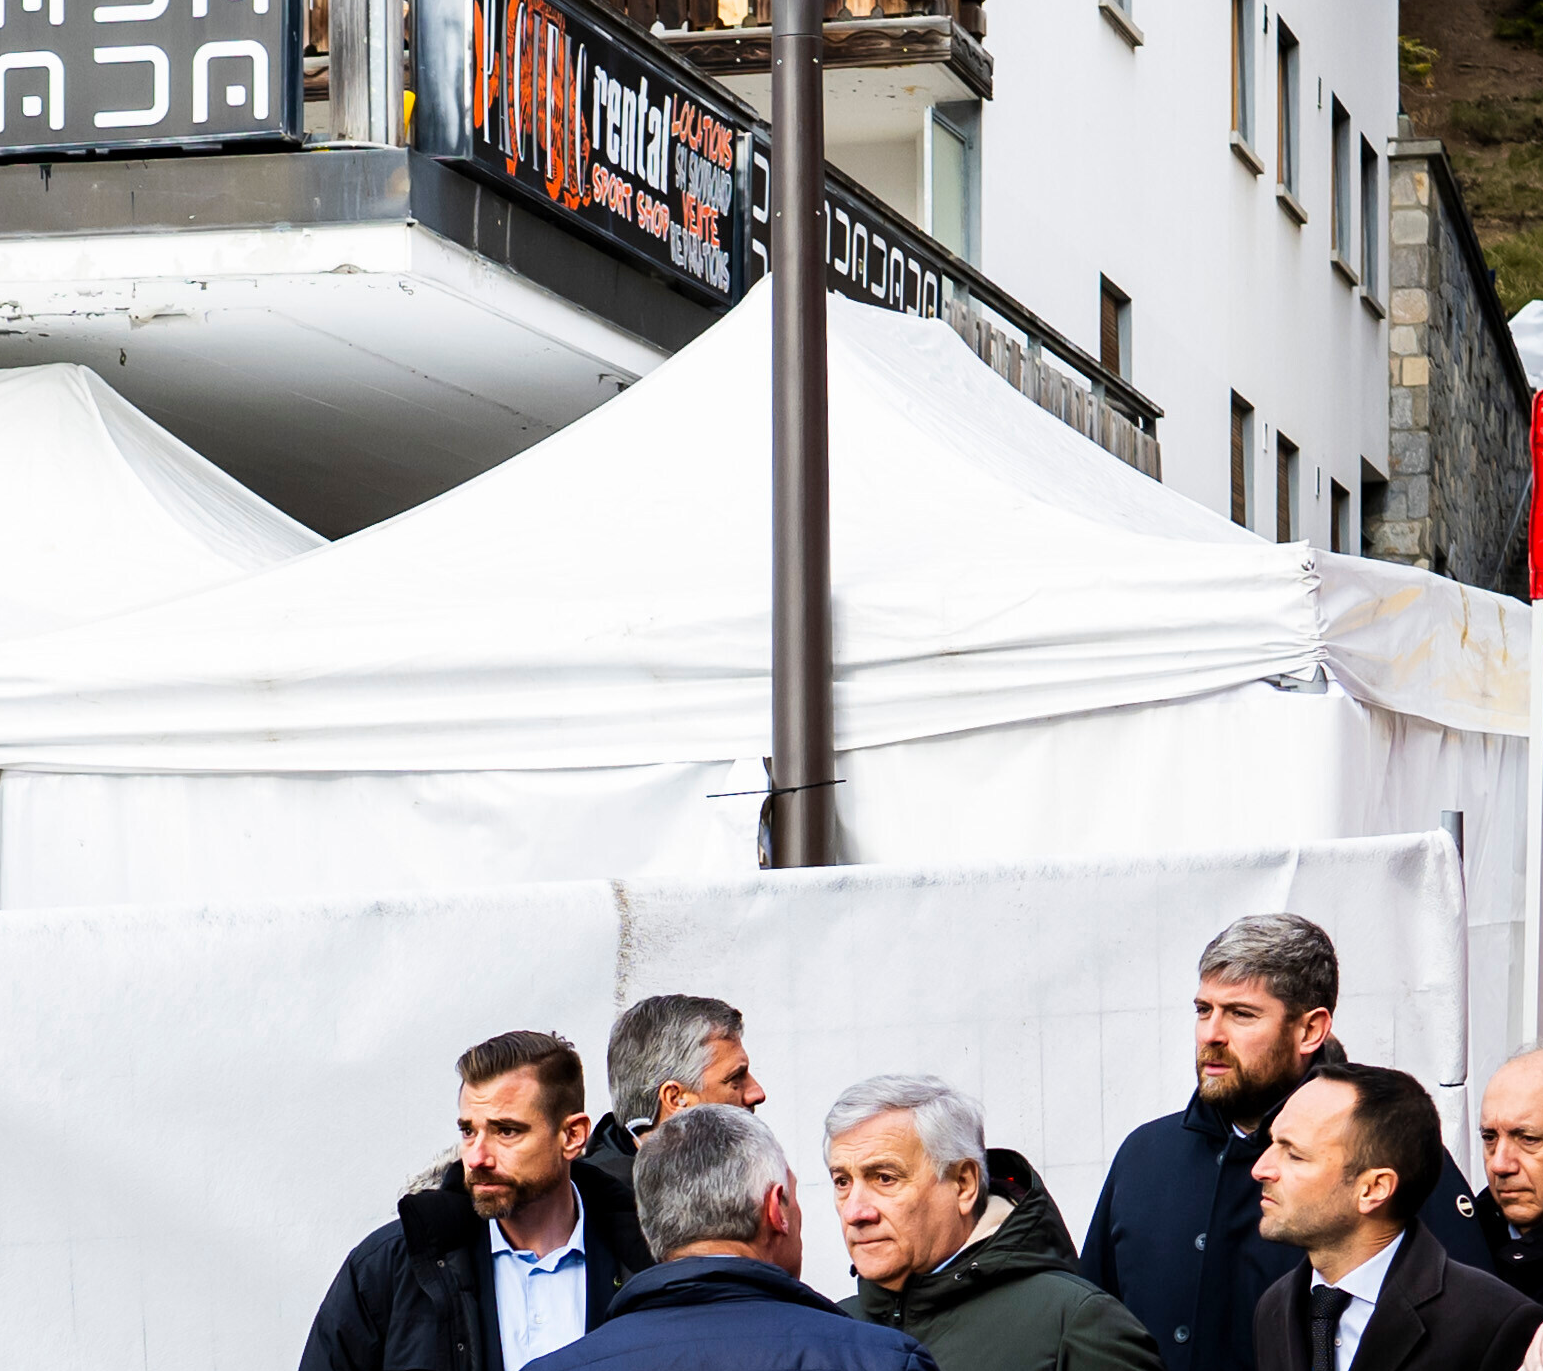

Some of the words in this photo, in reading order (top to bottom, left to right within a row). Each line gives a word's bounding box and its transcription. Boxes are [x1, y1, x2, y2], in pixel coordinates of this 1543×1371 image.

[592, 64, 672, 195] rental
[671, 93, 733, 171] LOCATIONS
[591, 162, 633, 222] SPORT
[636, 189, 670, 243] SHOP
[682, 189, 720, 248] VENTE
